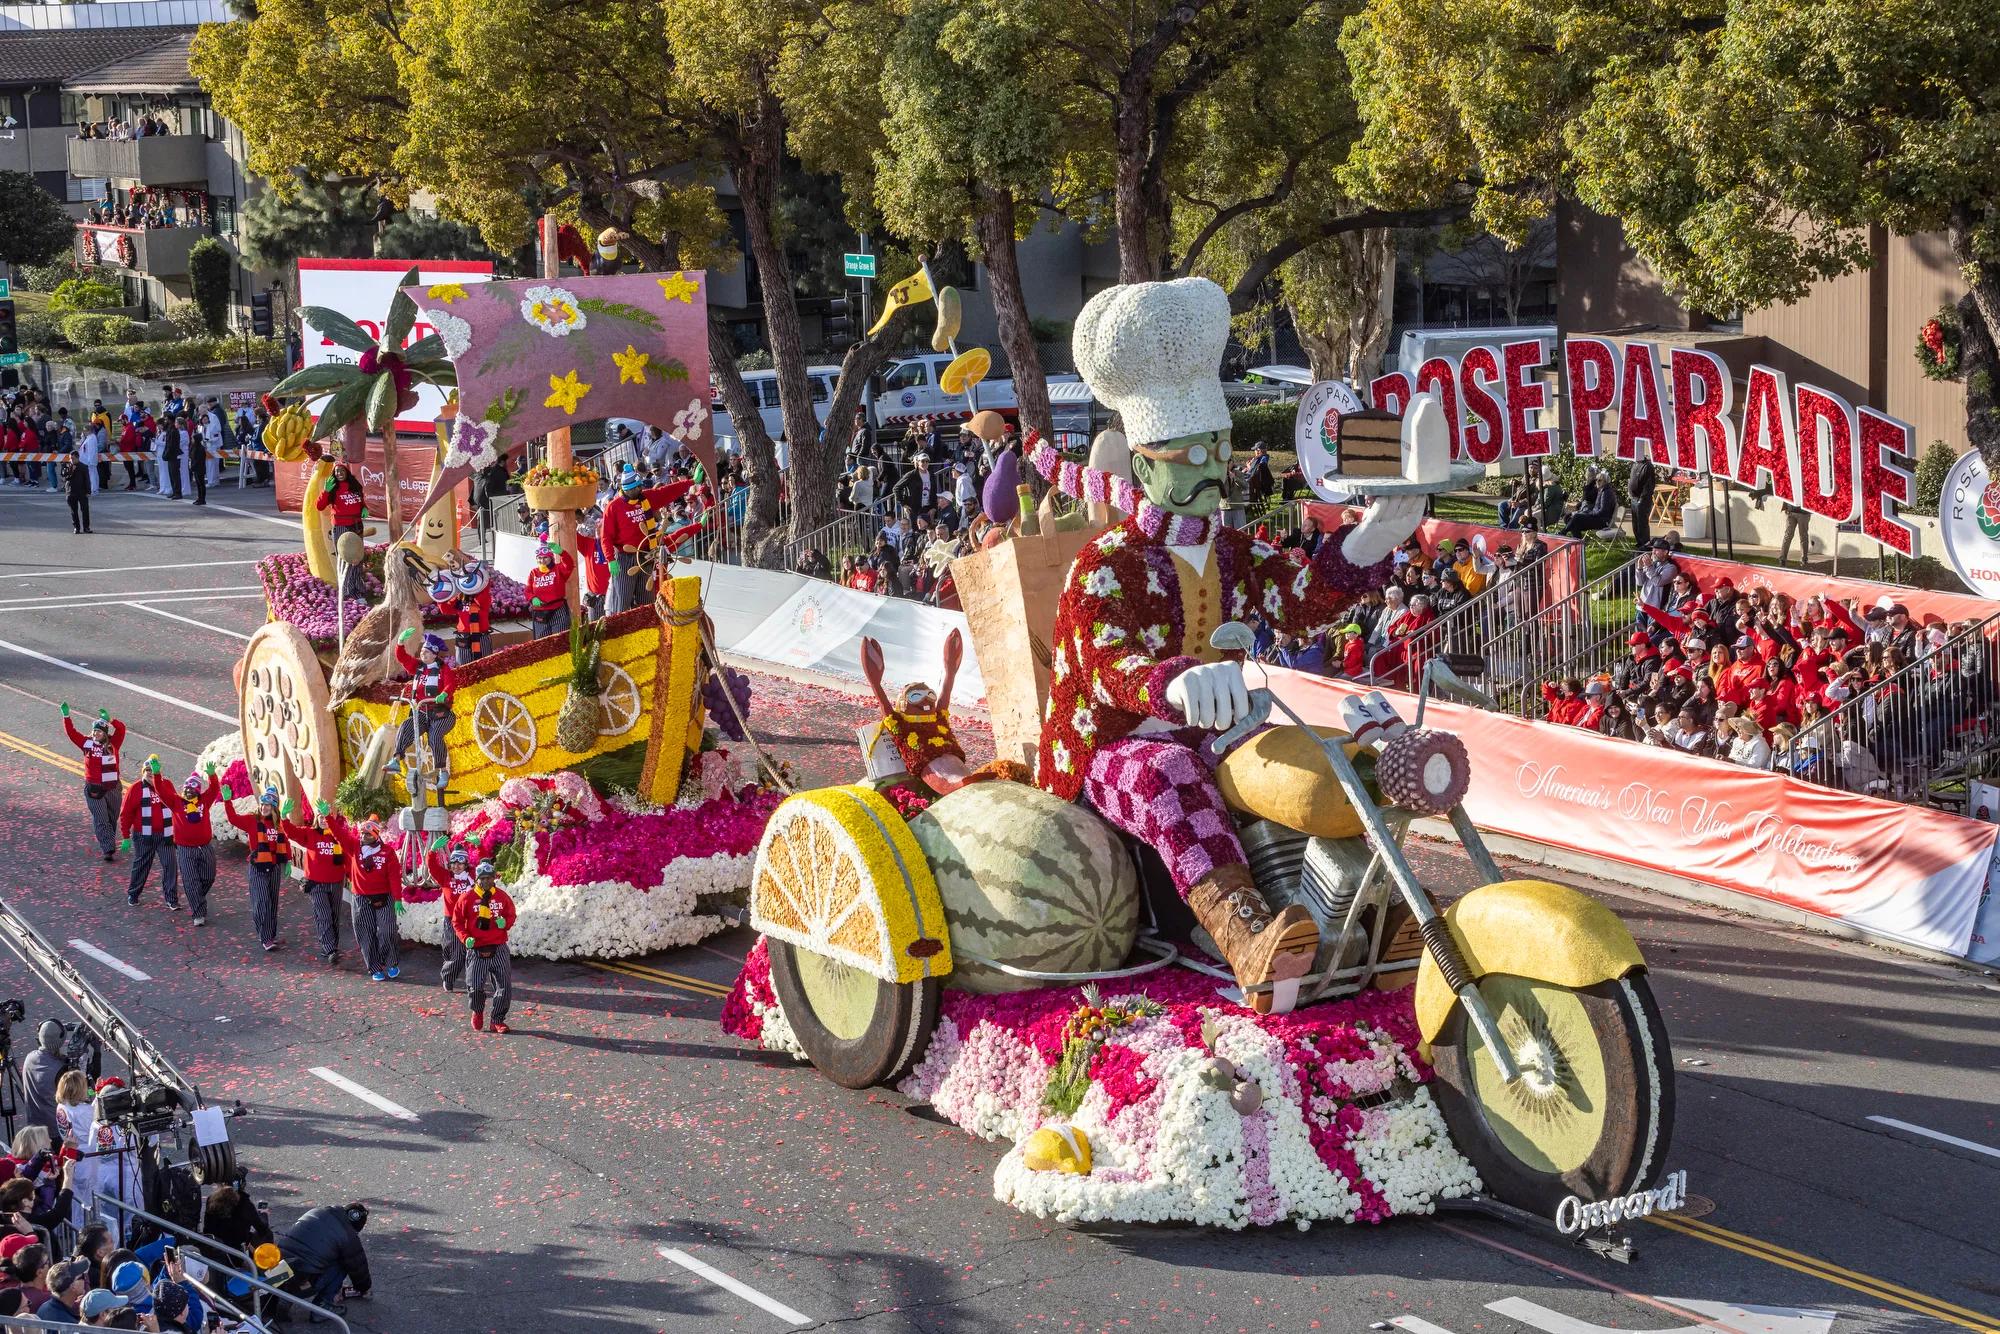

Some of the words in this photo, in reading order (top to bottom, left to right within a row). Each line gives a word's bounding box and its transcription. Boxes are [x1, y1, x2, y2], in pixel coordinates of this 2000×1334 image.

[1305, 392, 1323, 439] ROSE
[1565, 338, 1918, 560] PARADE
[1953, 461, 1981, 520] ROSE
[1358, 705, 1373, 717] S
[1515, 760, 1611, 810] America's
[1617, 782, 1673, 825] New
[1680, 795, 1737, 845] Year
[1556, 1169, 1687, 1234] Onward!
